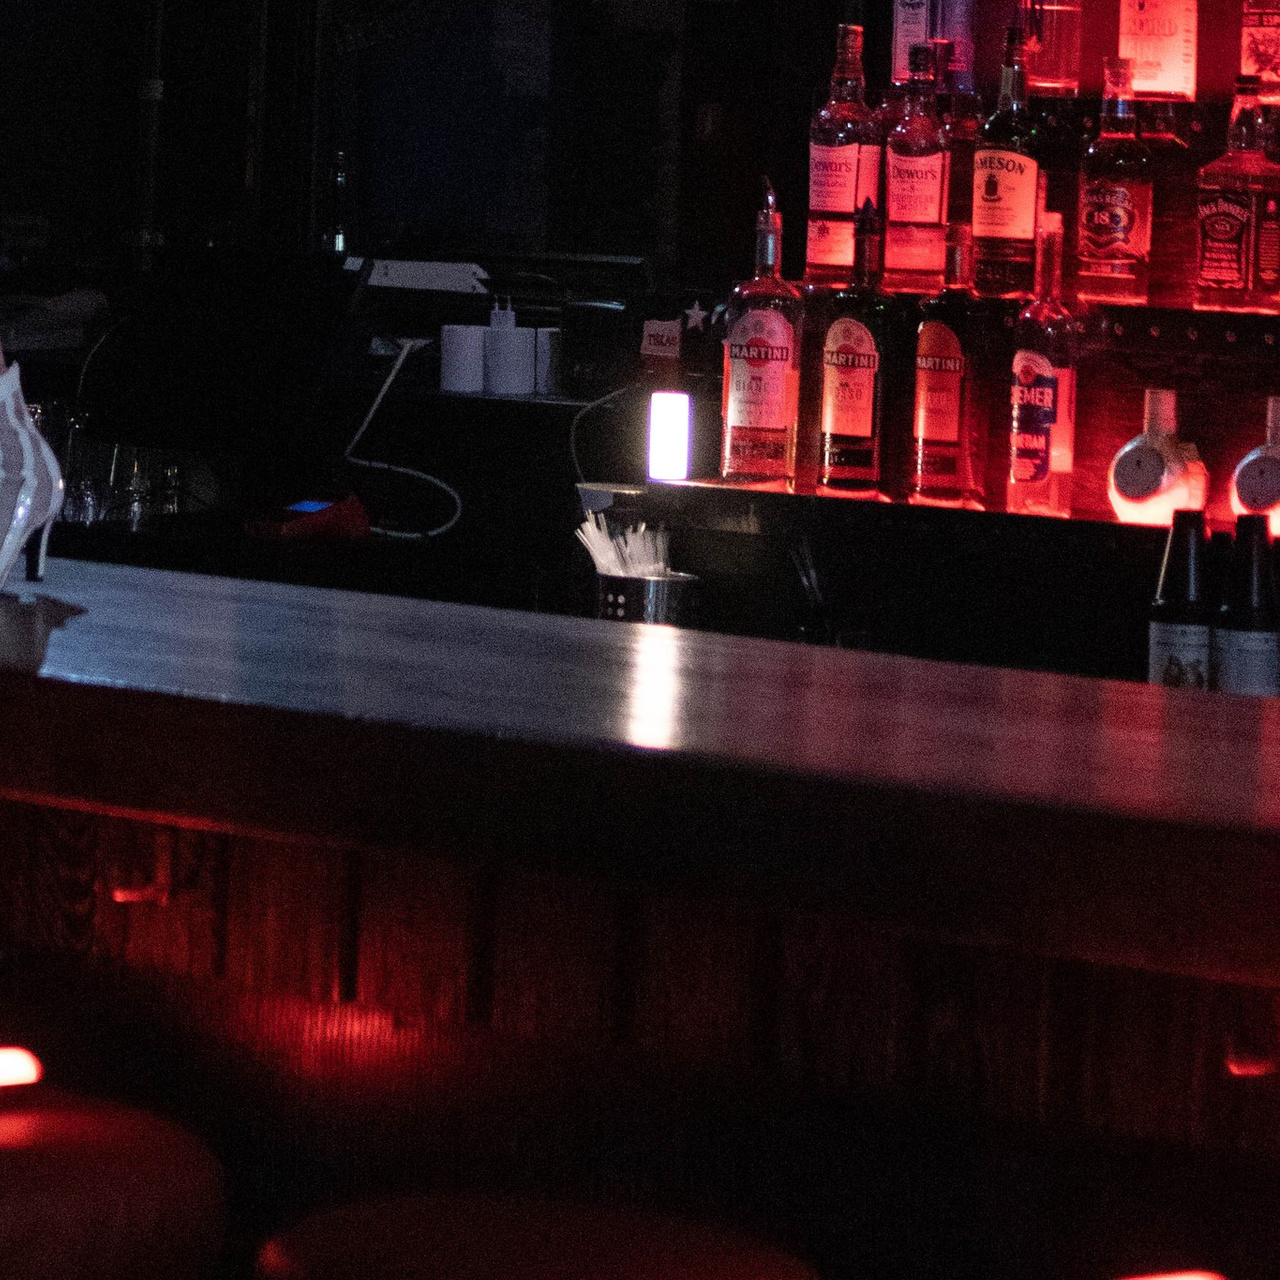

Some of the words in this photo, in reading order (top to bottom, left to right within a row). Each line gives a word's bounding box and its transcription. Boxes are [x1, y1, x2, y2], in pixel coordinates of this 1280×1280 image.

[976, 155, 1027, 176] MESON
[731, 345, 786, 360] MARTINI
[824, 351, 874, 368] MARTINI
